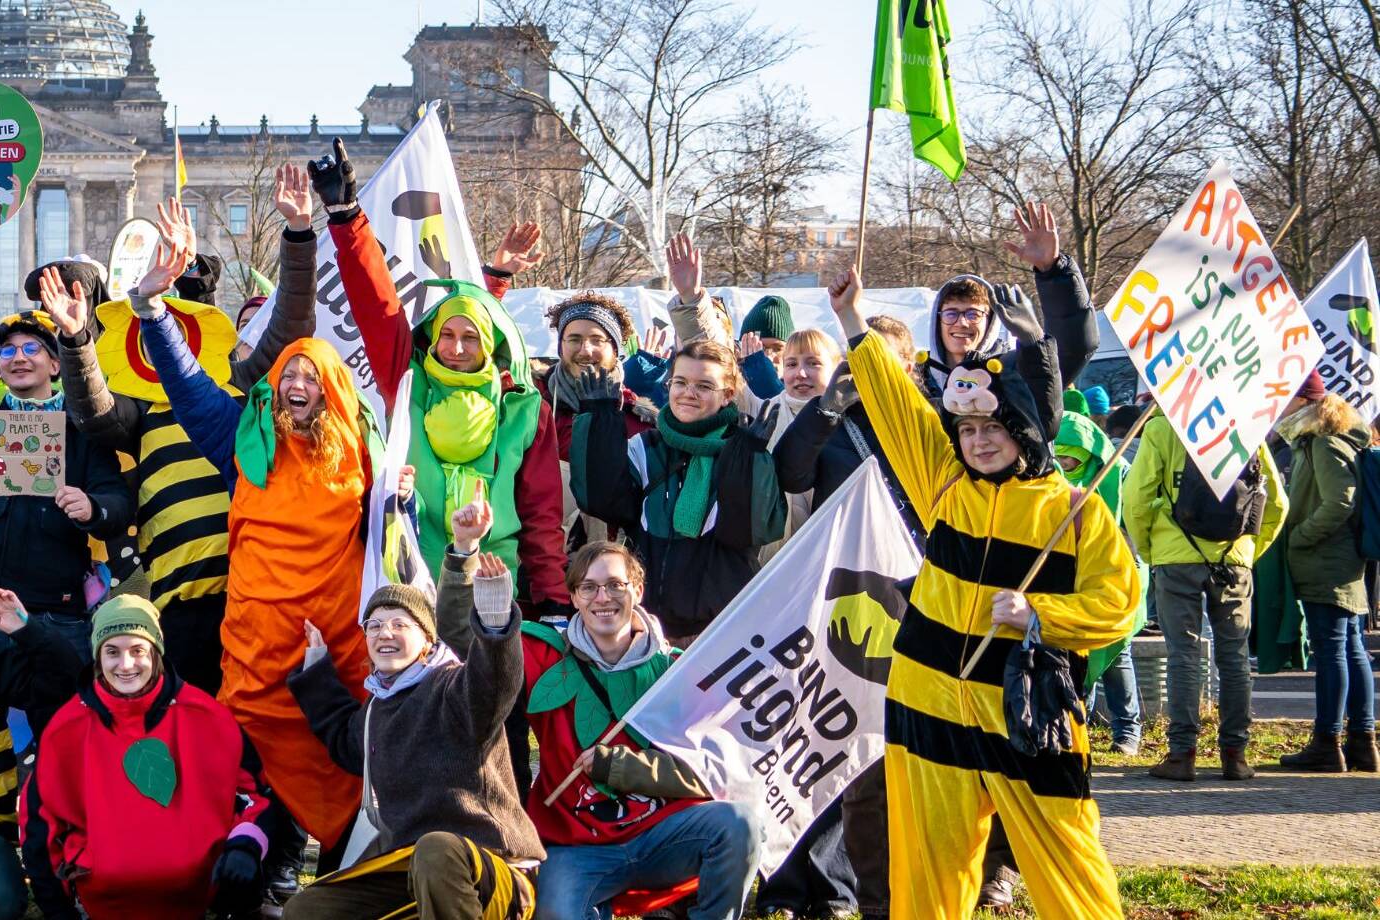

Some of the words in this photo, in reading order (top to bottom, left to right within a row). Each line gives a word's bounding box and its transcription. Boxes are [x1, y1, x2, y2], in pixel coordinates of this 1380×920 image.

[1183, 180, 1309, 424] ARTGERECHT
[1221, 313, 1262, 392] NUR
[10, 423, 39, 434] PLANET
[42, 423, 50, 434] B
